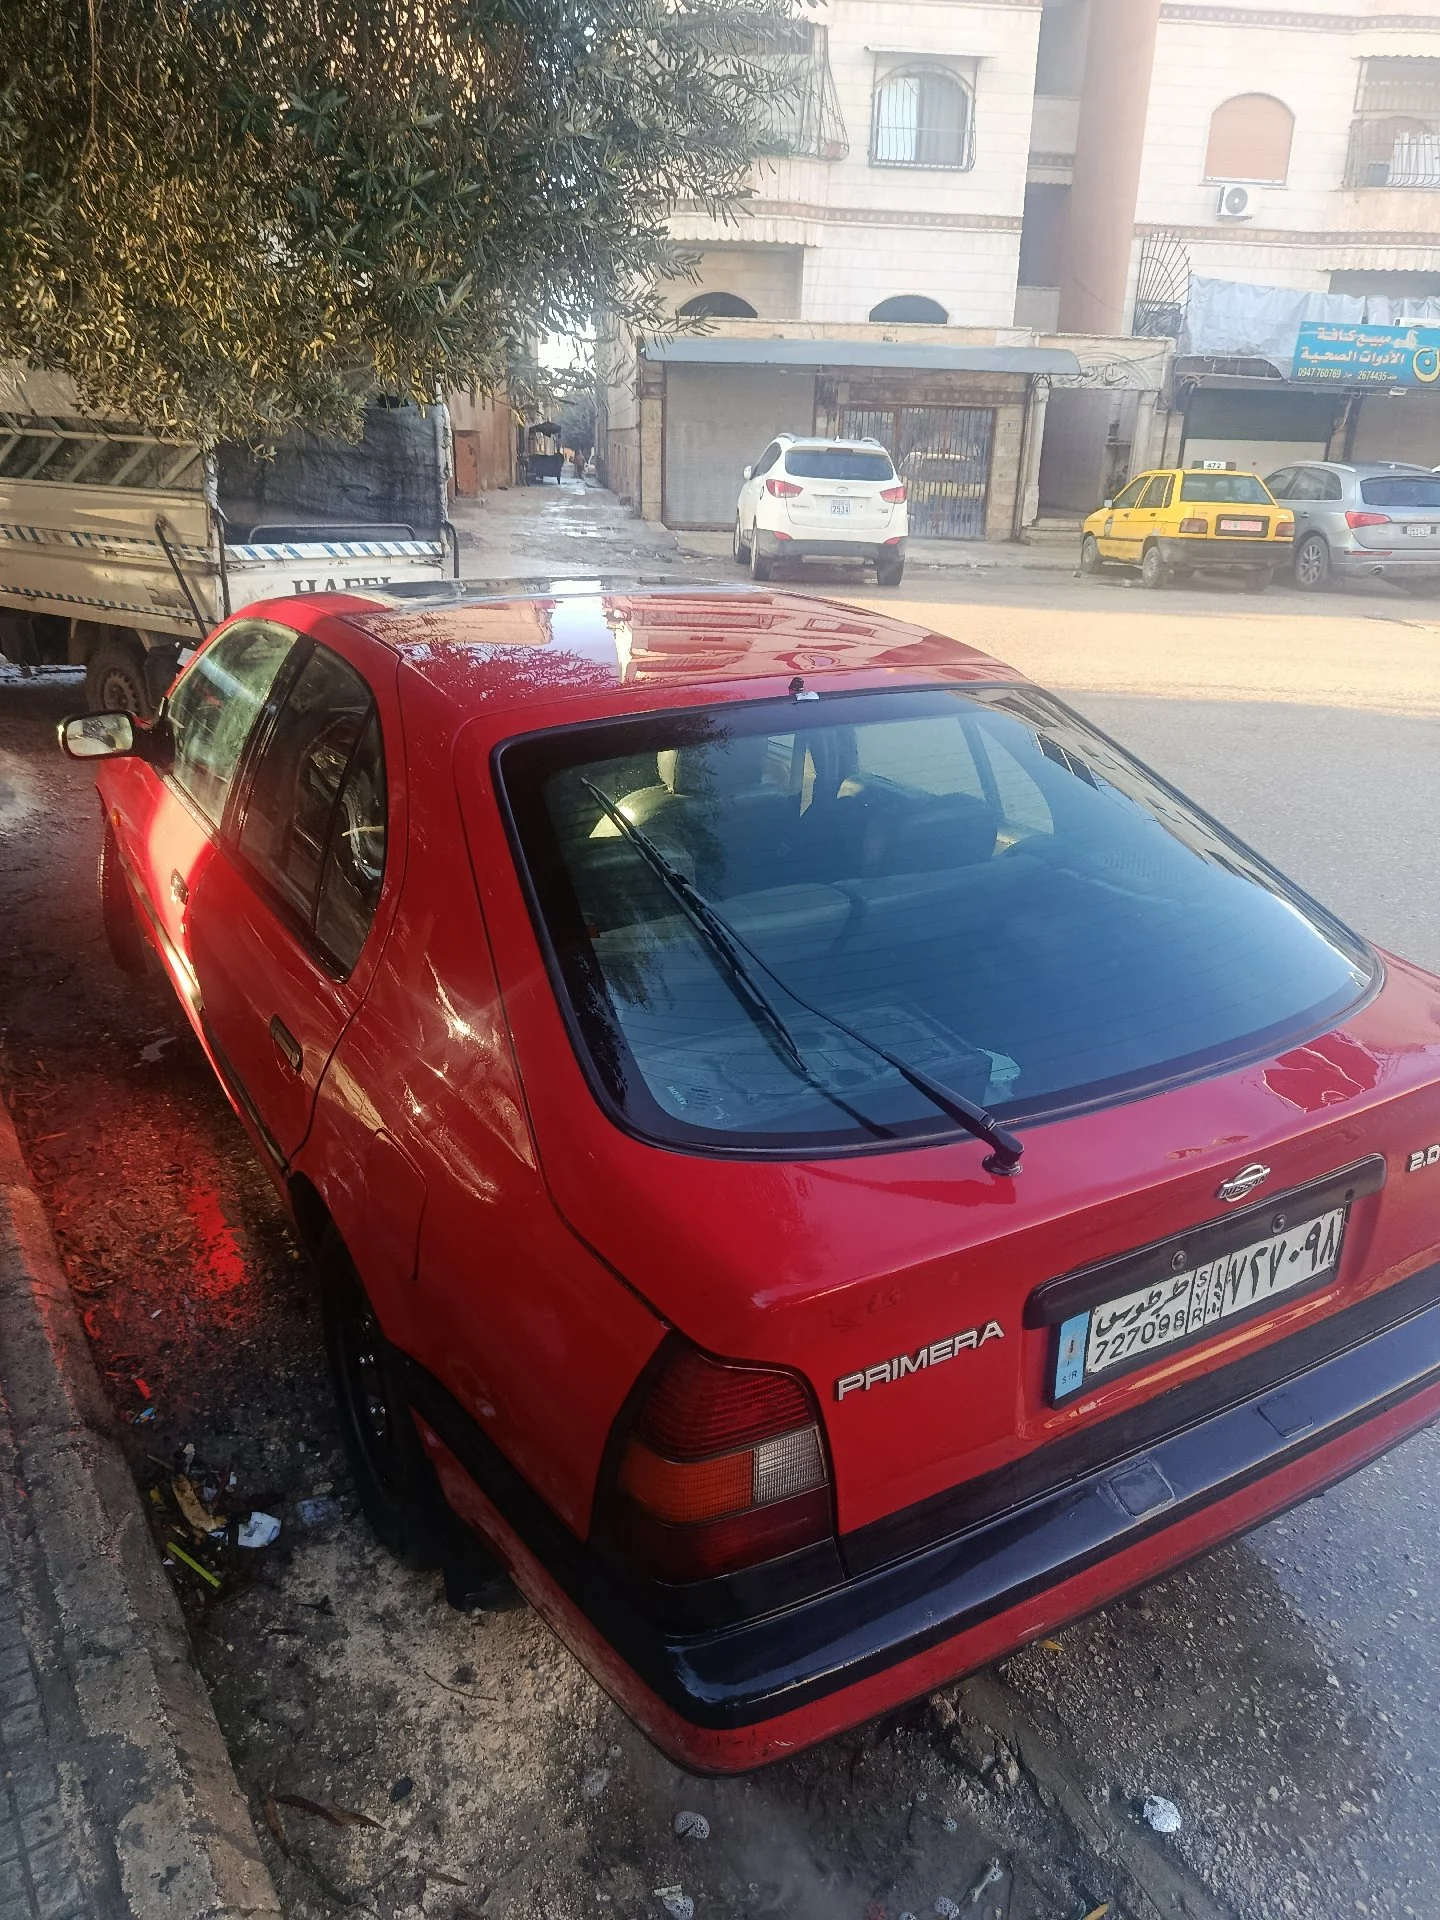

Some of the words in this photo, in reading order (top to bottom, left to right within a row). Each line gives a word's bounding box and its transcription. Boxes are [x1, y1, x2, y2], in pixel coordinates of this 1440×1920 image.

[1317, 327, 1357, 342] كافة
[1356, 333, 1392, 347] مبيع
[1300, 346, 1357, 363] الصحية
[1357, 370, 1387, 381] 2674435
[1221, 1174, 1268, 1198] NISSAN
[1094, 1309, 1186, 1365] 727098
[835, 1320, 1005, 1402] PRIMERA
